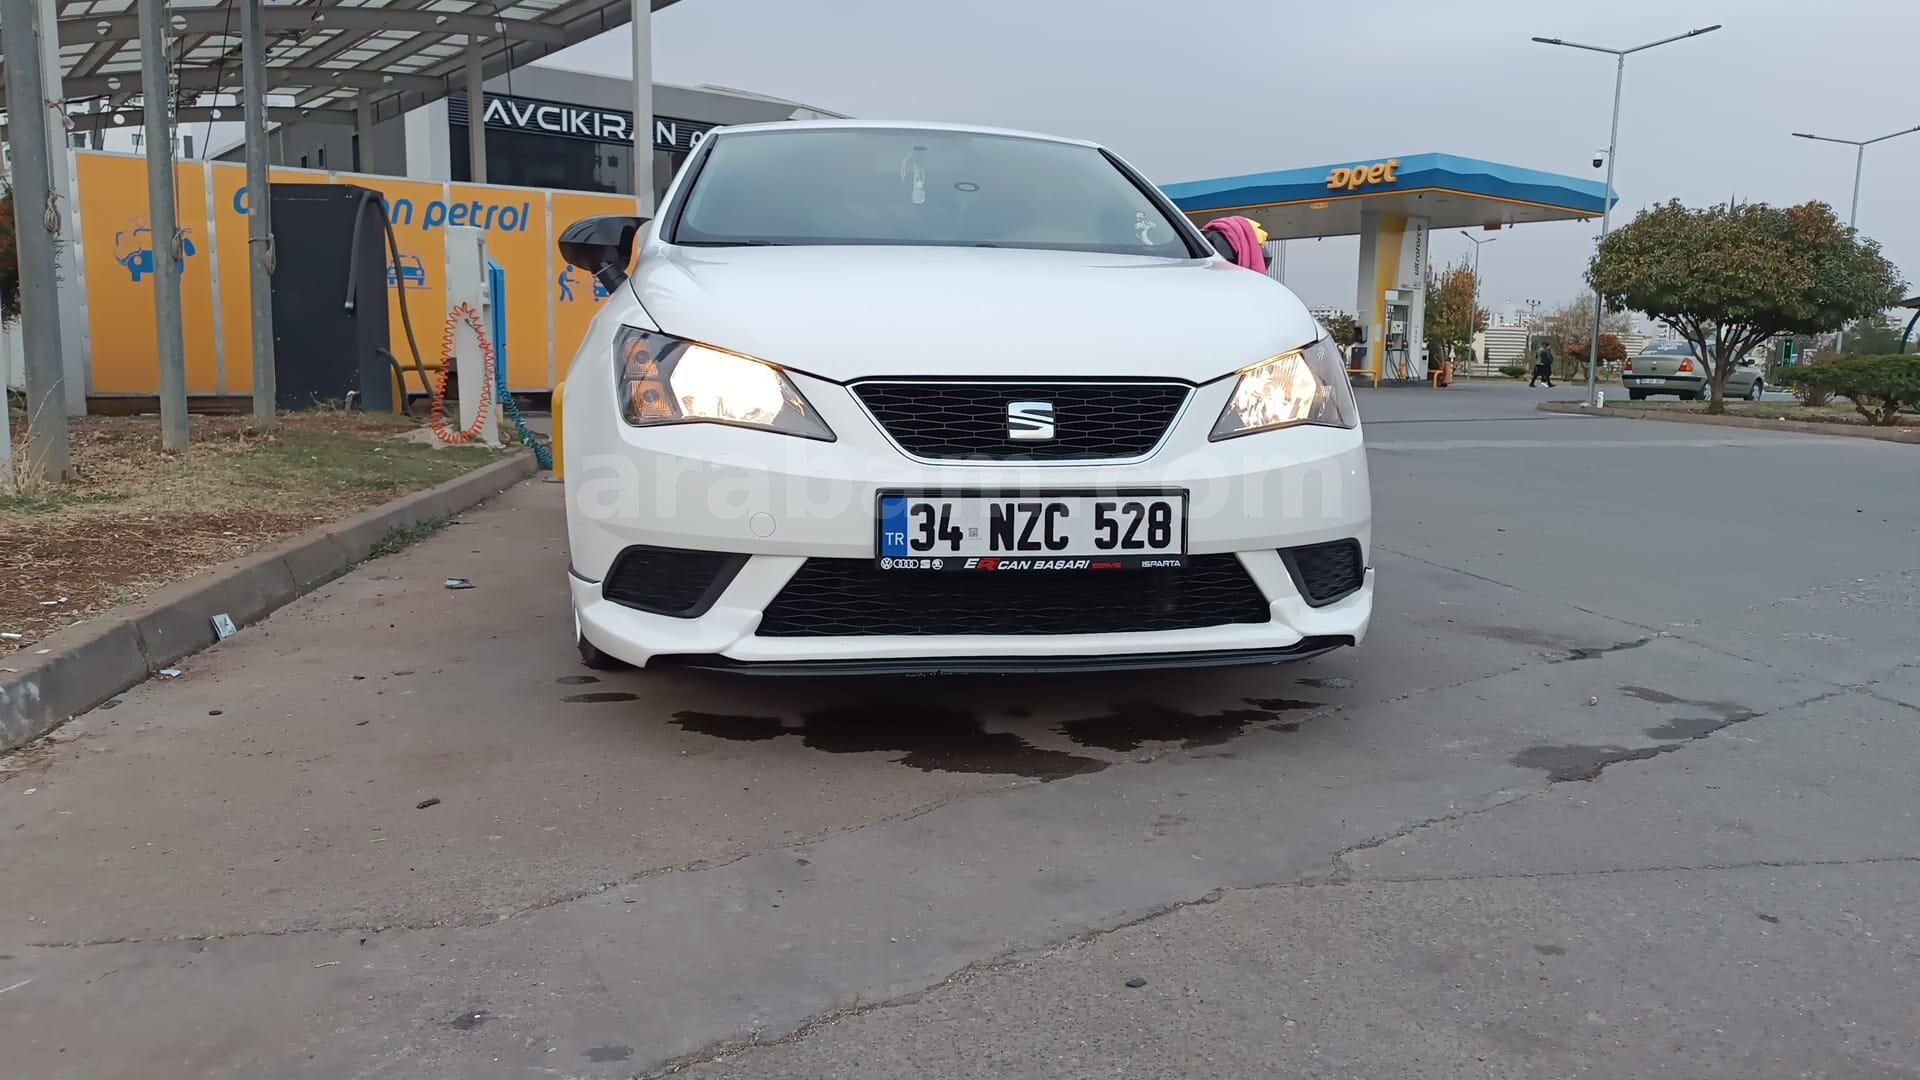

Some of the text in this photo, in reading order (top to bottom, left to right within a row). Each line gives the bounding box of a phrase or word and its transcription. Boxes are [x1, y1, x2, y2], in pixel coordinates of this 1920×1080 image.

[483, 99, 676, 145] AVCIKIRN
[1326, 159, 1400, 190] opet
[422, 200, 529, 231] petrol
[885, 502, 1172, 551] TR 34 NZC 528
